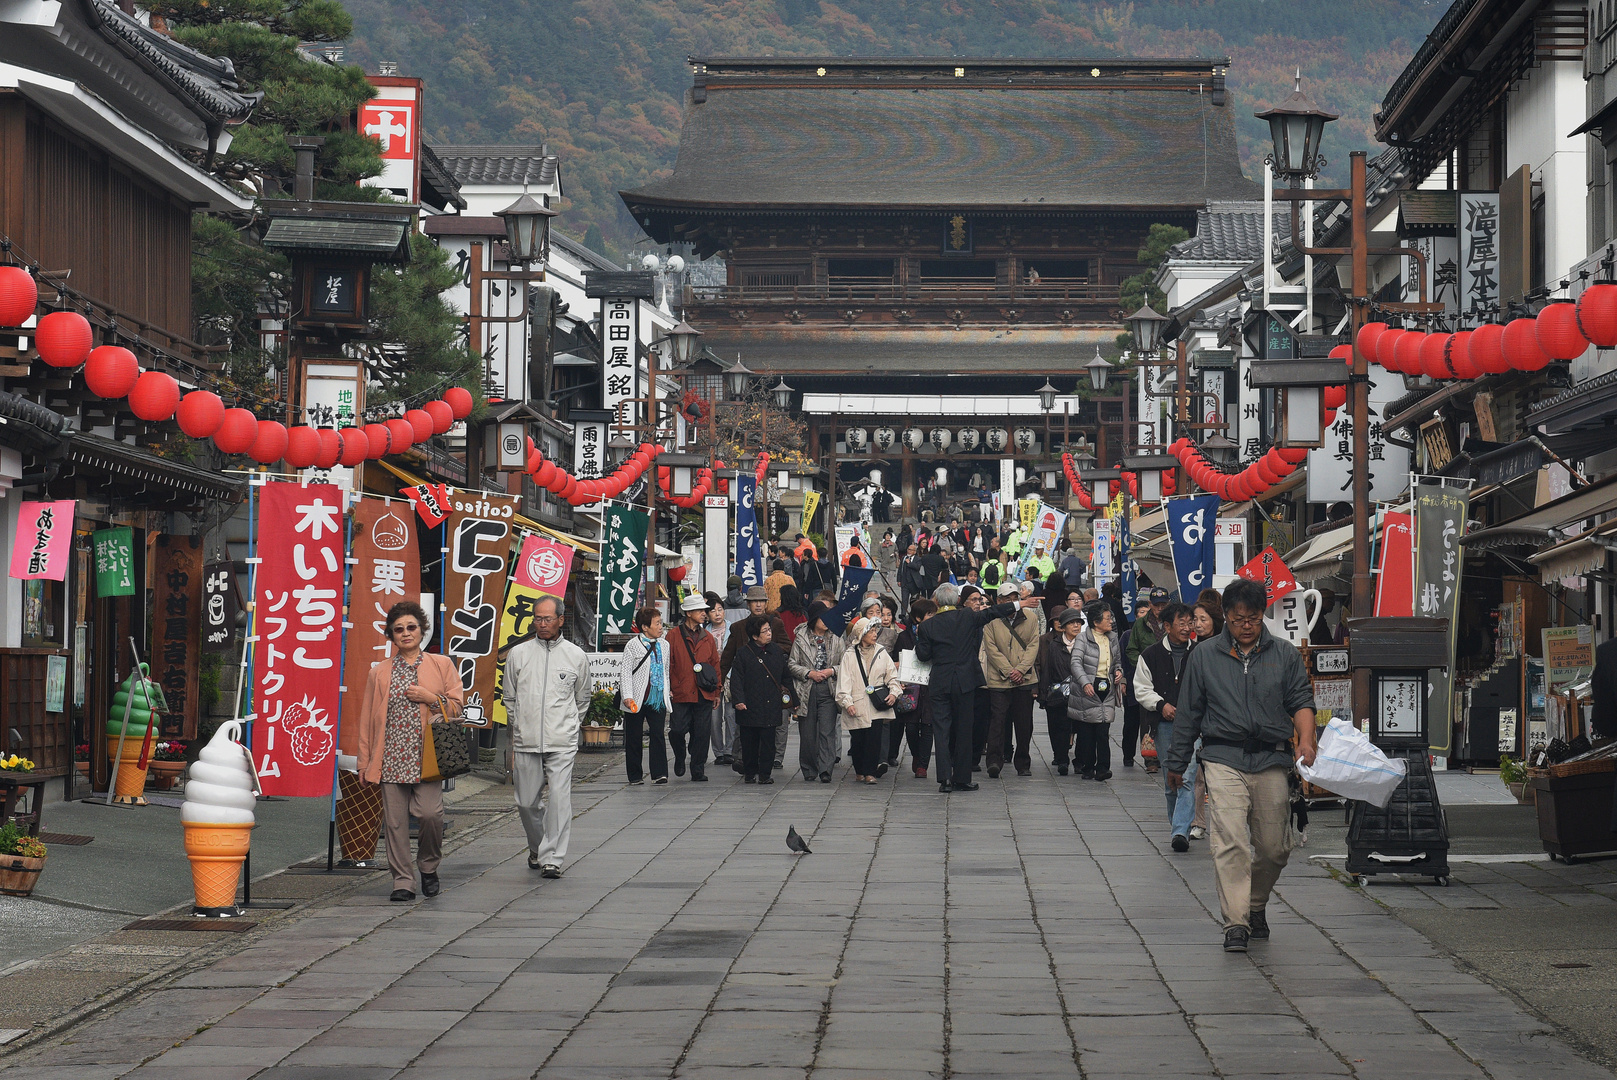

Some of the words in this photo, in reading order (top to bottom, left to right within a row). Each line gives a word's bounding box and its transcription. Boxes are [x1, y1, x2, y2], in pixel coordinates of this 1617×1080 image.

[326, 275, 342, 304] 松屋
[607, 298, 632, 443] 高田屋銘産
[582, 426, 598, 480] 雨宮佛
[292, 498, 339, 669] 木いちご
[1421, 582, 1440, 614] 抹
[1283, 597, 1298, 640] コーヒー
[258, 590, 290, 778] ソフトクリーム
